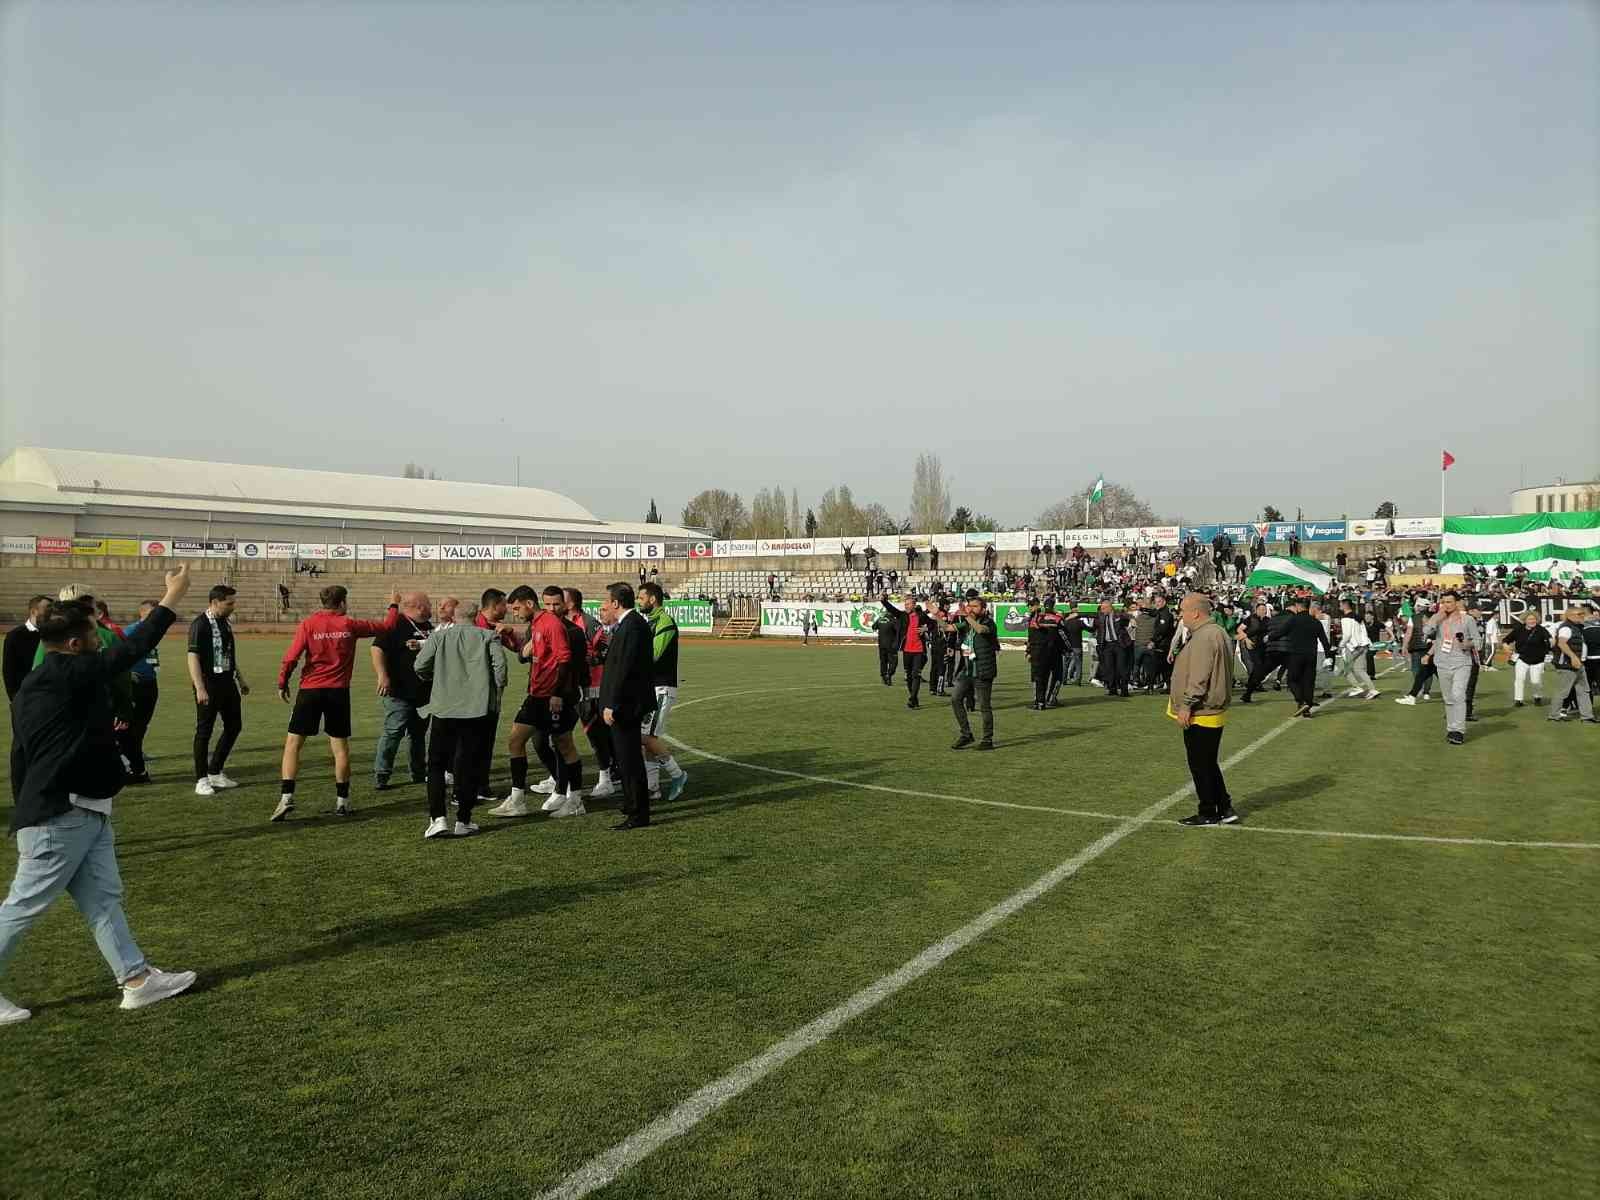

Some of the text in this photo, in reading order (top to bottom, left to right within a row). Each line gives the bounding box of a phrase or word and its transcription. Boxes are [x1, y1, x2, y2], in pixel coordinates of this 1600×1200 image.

[1315, 527, 1344, 536] negmar
[443, 546, 492, 558] YALOVA
[822, 609, 852, 628] SEN
